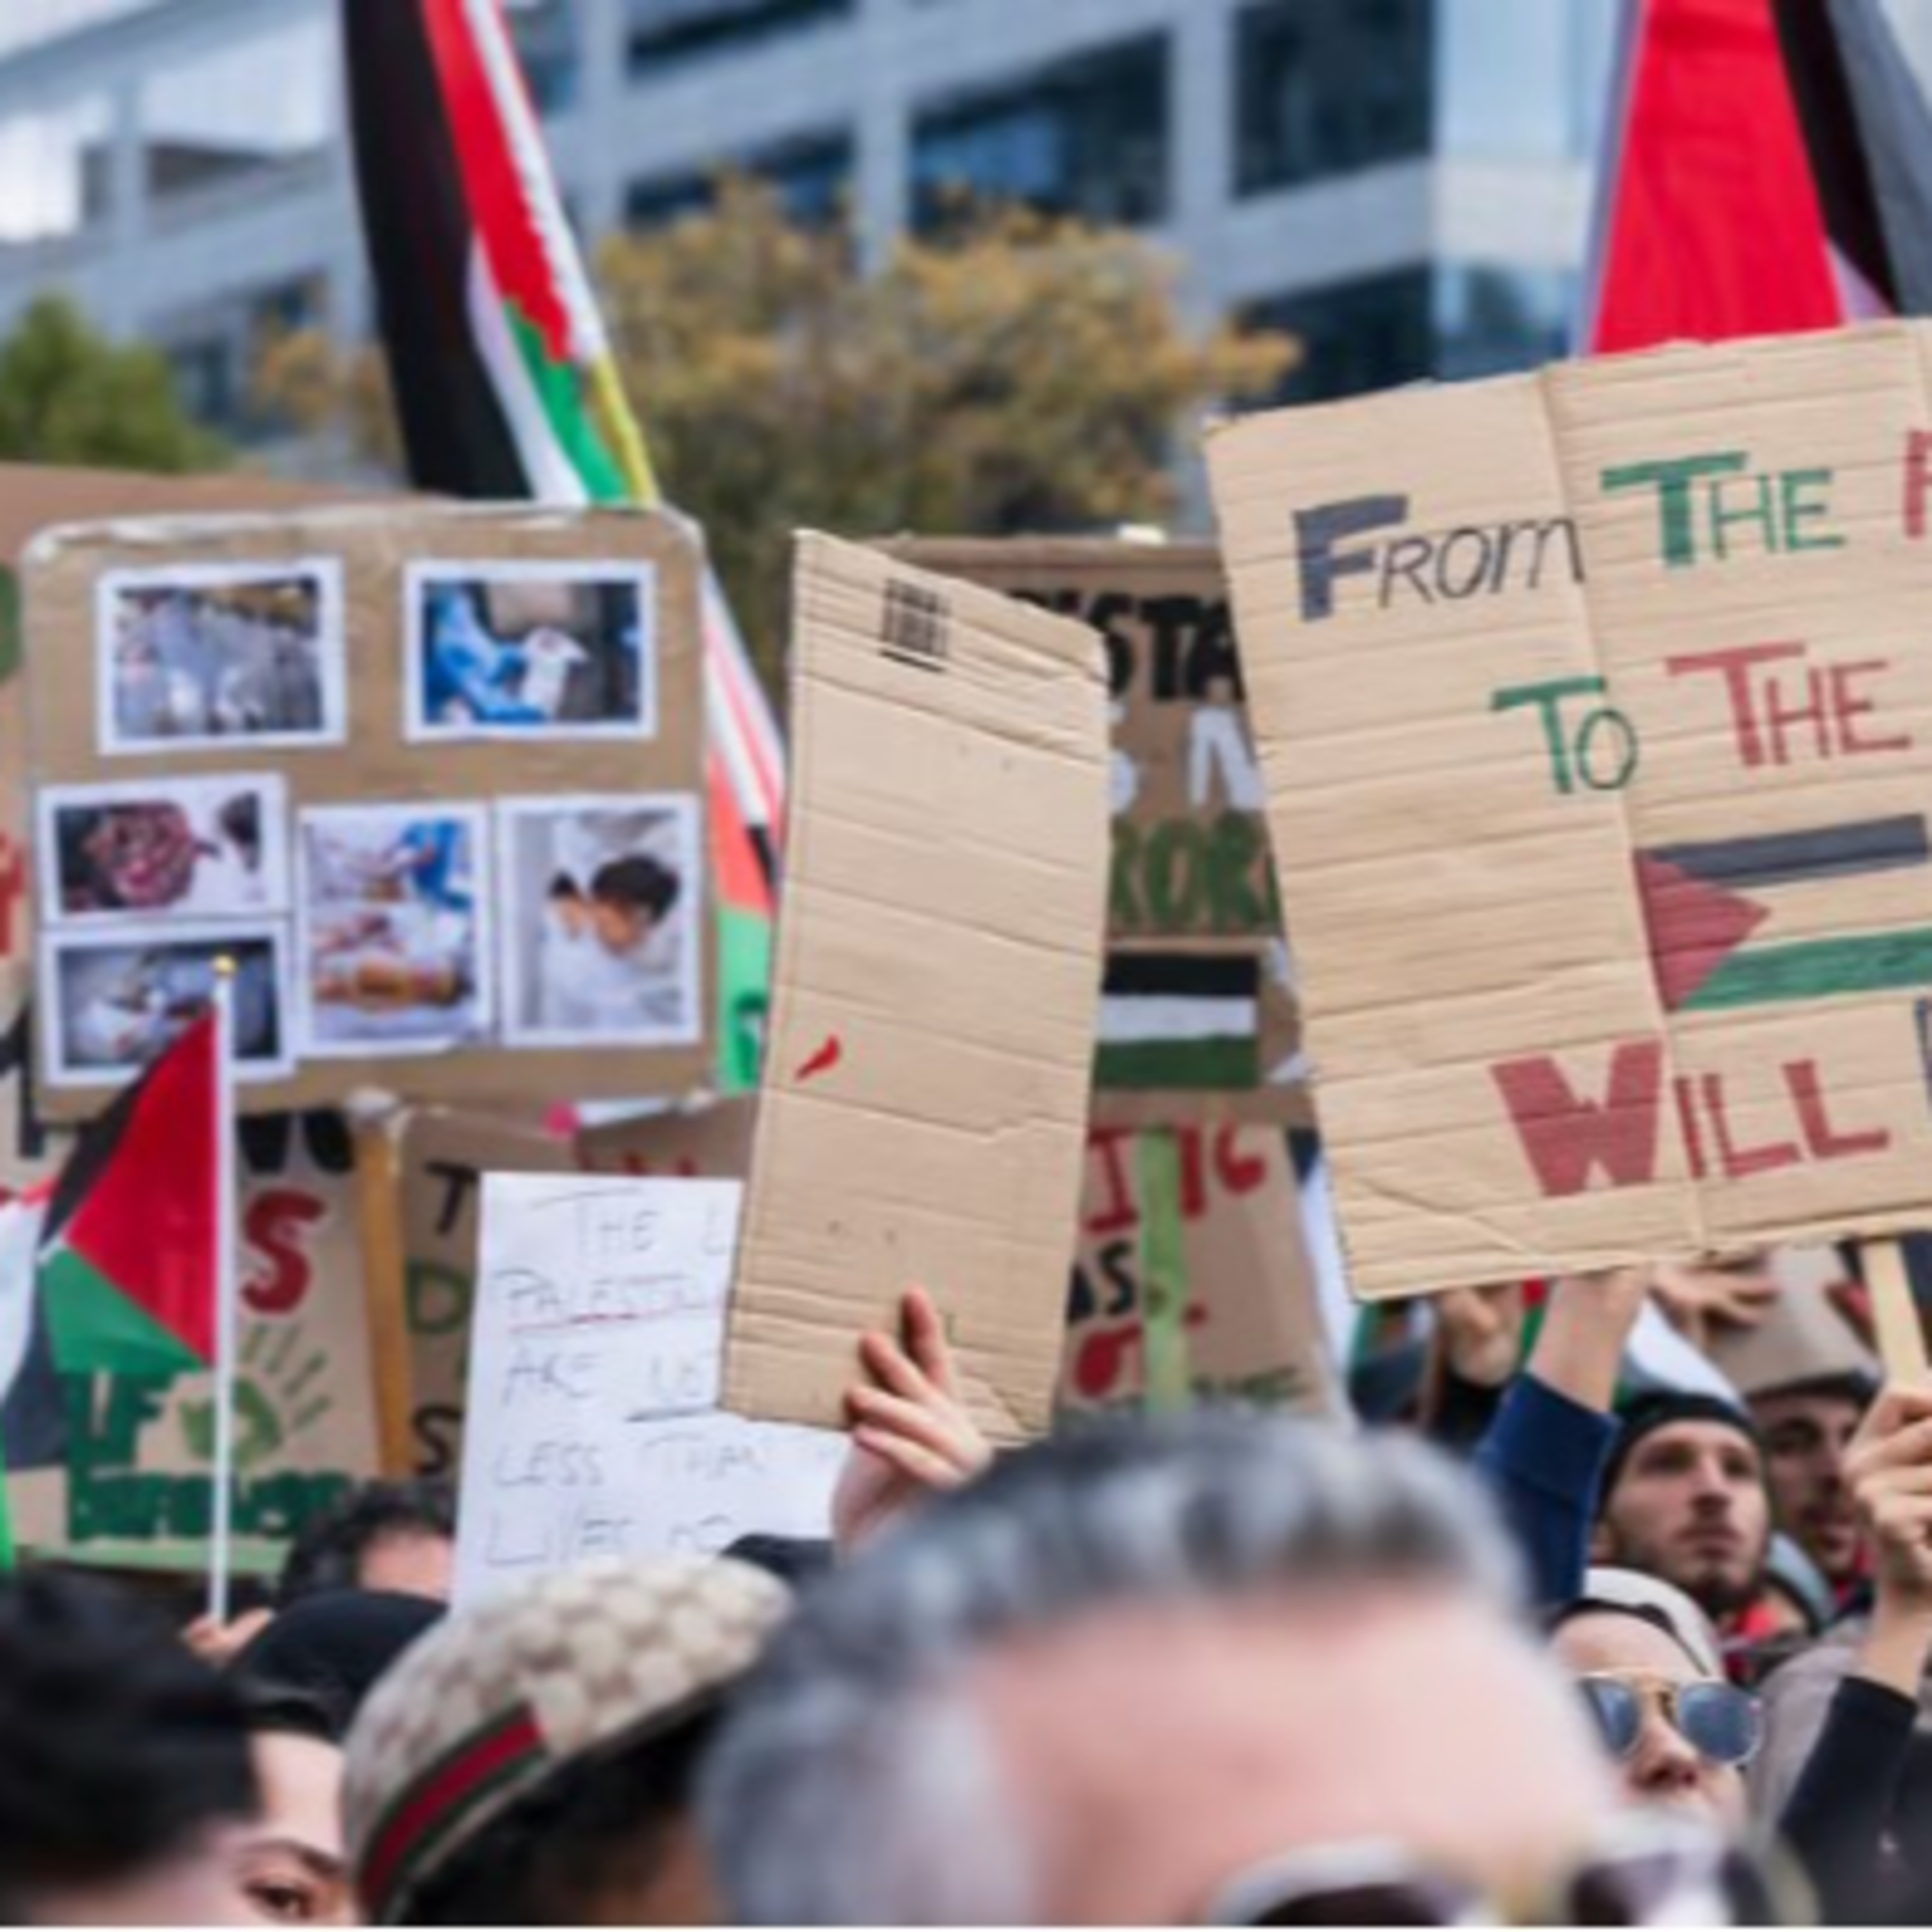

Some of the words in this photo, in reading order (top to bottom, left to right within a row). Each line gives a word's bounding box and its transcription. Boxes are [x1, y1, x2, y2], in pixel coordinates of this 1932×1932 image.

[1600, 451, 1846, 569] THE
[1490, 675, 1639, 795] TO
[1665, 640, 1912, 768] THE
[1487, 1038, 1891, 1198] WILL
[491, 1439, 605, 1488] LESS
